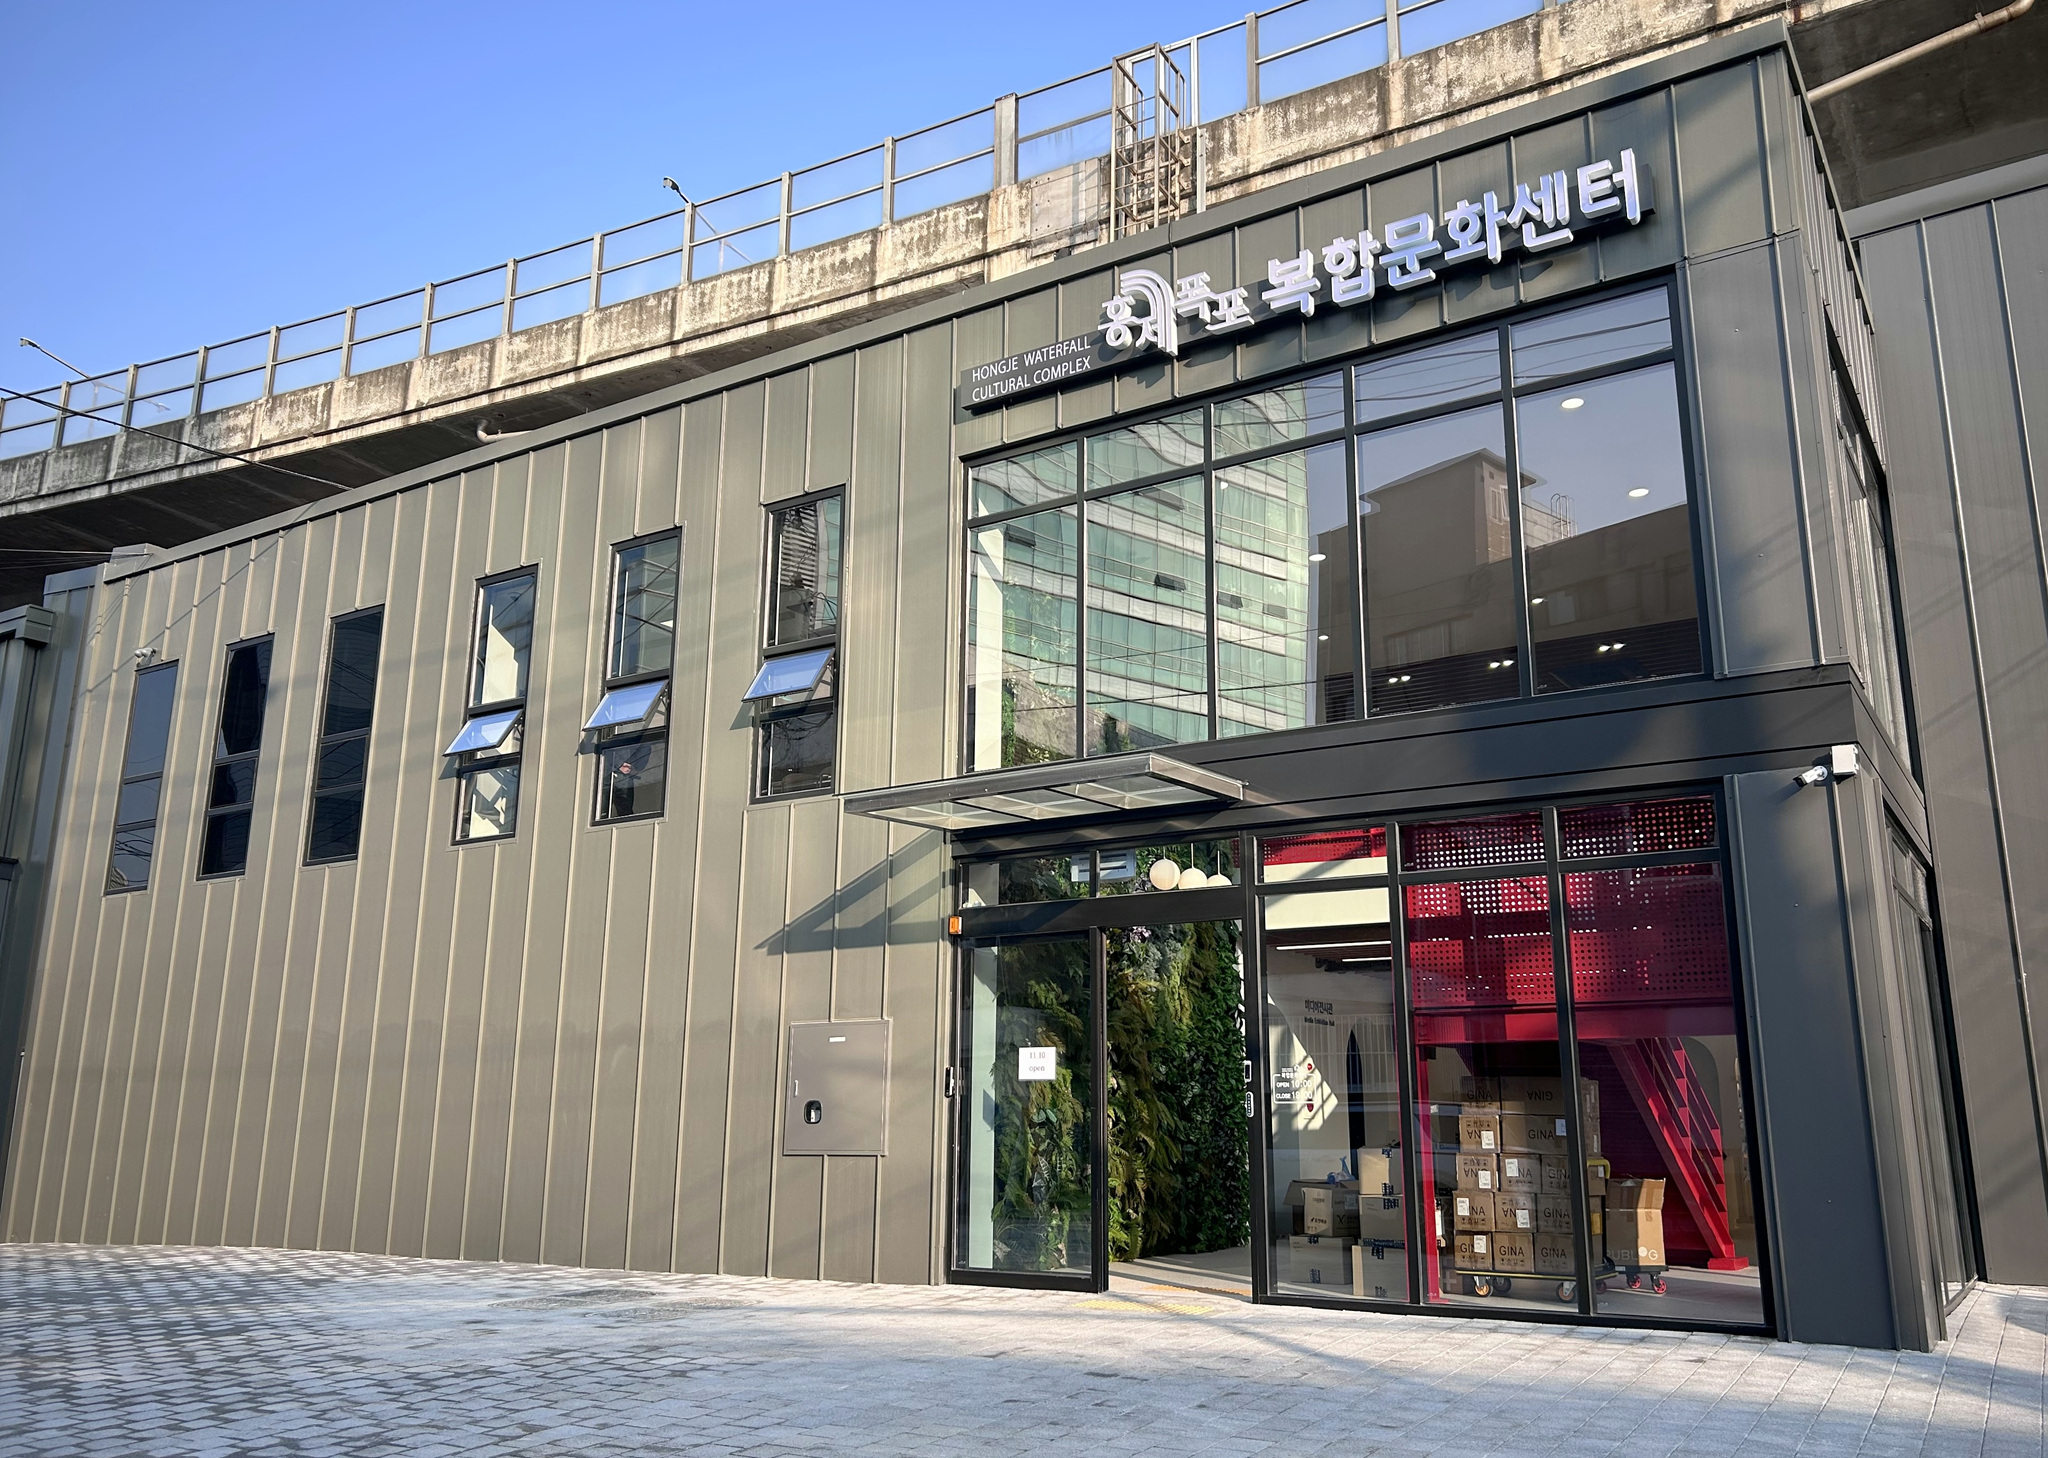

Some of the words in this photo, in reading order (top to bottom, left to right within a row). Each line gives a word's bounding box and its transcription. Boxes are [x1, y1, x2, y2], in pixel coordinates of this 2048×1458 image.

[1261, 147, 1641, 318] 복합문화센터
[972, 356, 1019, 382] HONGJE
[1023, 336, 1091, 367] WATERFALL
[972, 374, 1031, 402] CULTURAL
[1033, 355, 1091, 384] COMPLEX
[1291, 1079, 1312, 1088] 10:00
[1291, 1091, 1313, 1099] 1900
[1467, 1090, 1493, 1100] GINA
[1527, 1090, 1553, 1101] GINA
[1528, 1129, 1554, 1140] GINA
[1548, 1168, 1570, 1179] GIN
[1469, 1205, 1486, 1216] INA
[1543, 1207, 1570, 1219] GINA
[1499, 1245, 1524, 1257] GINA
[1541, 1247, 1567, 1259] GINA
